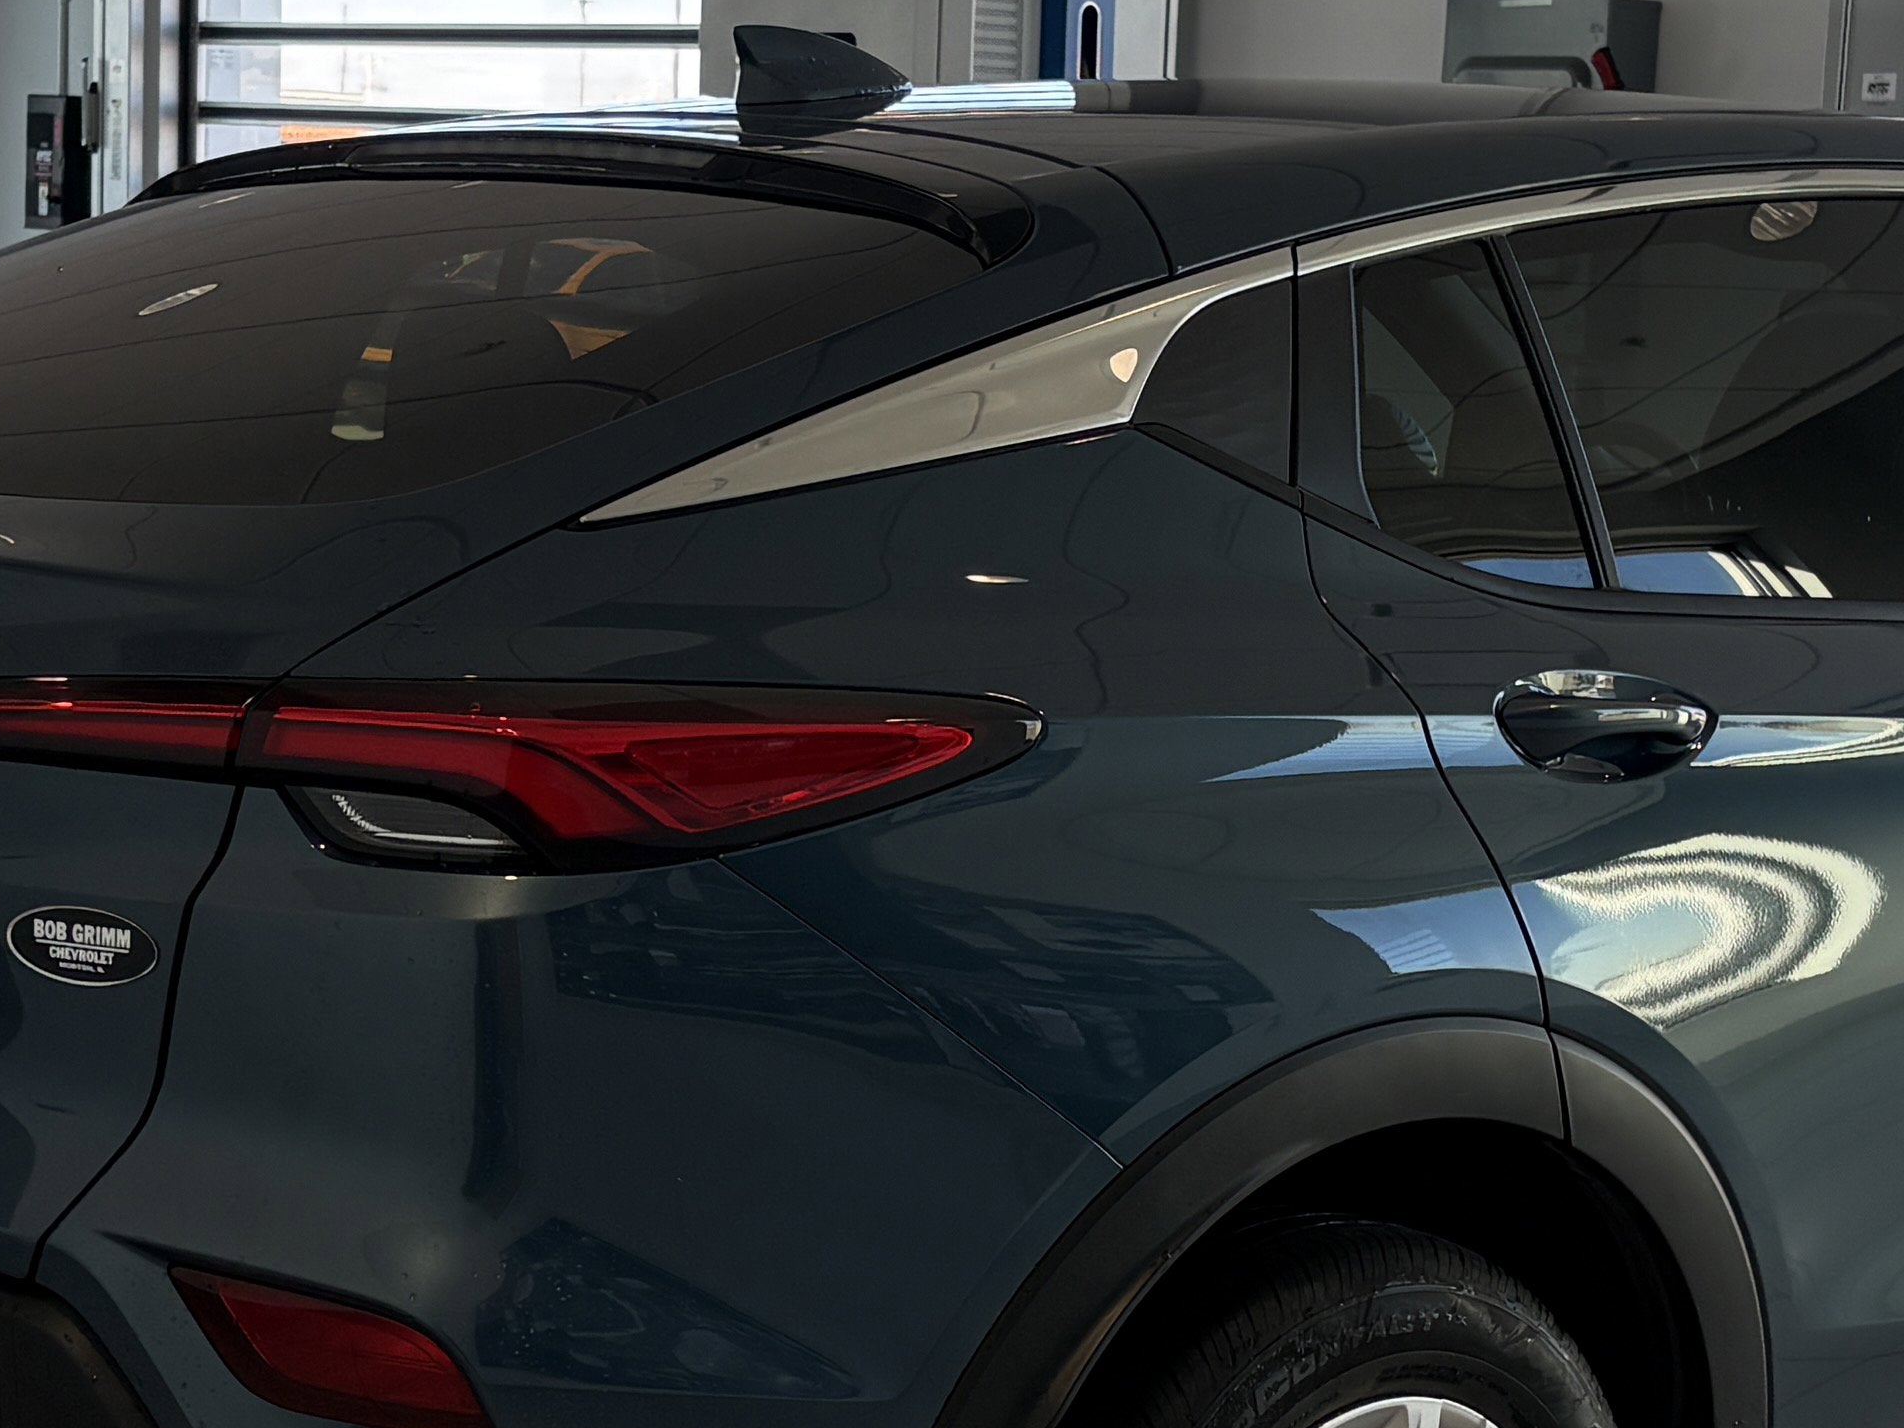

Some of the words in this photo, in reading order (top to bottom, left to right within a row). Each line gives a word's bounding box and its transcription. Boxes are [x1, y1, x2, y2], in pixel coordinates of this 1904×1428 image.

[33, 918, 67, 941] BOB
[72, 923, 131, 949] GRIMM
[49, 945, 115, 965] CHEVROLET
